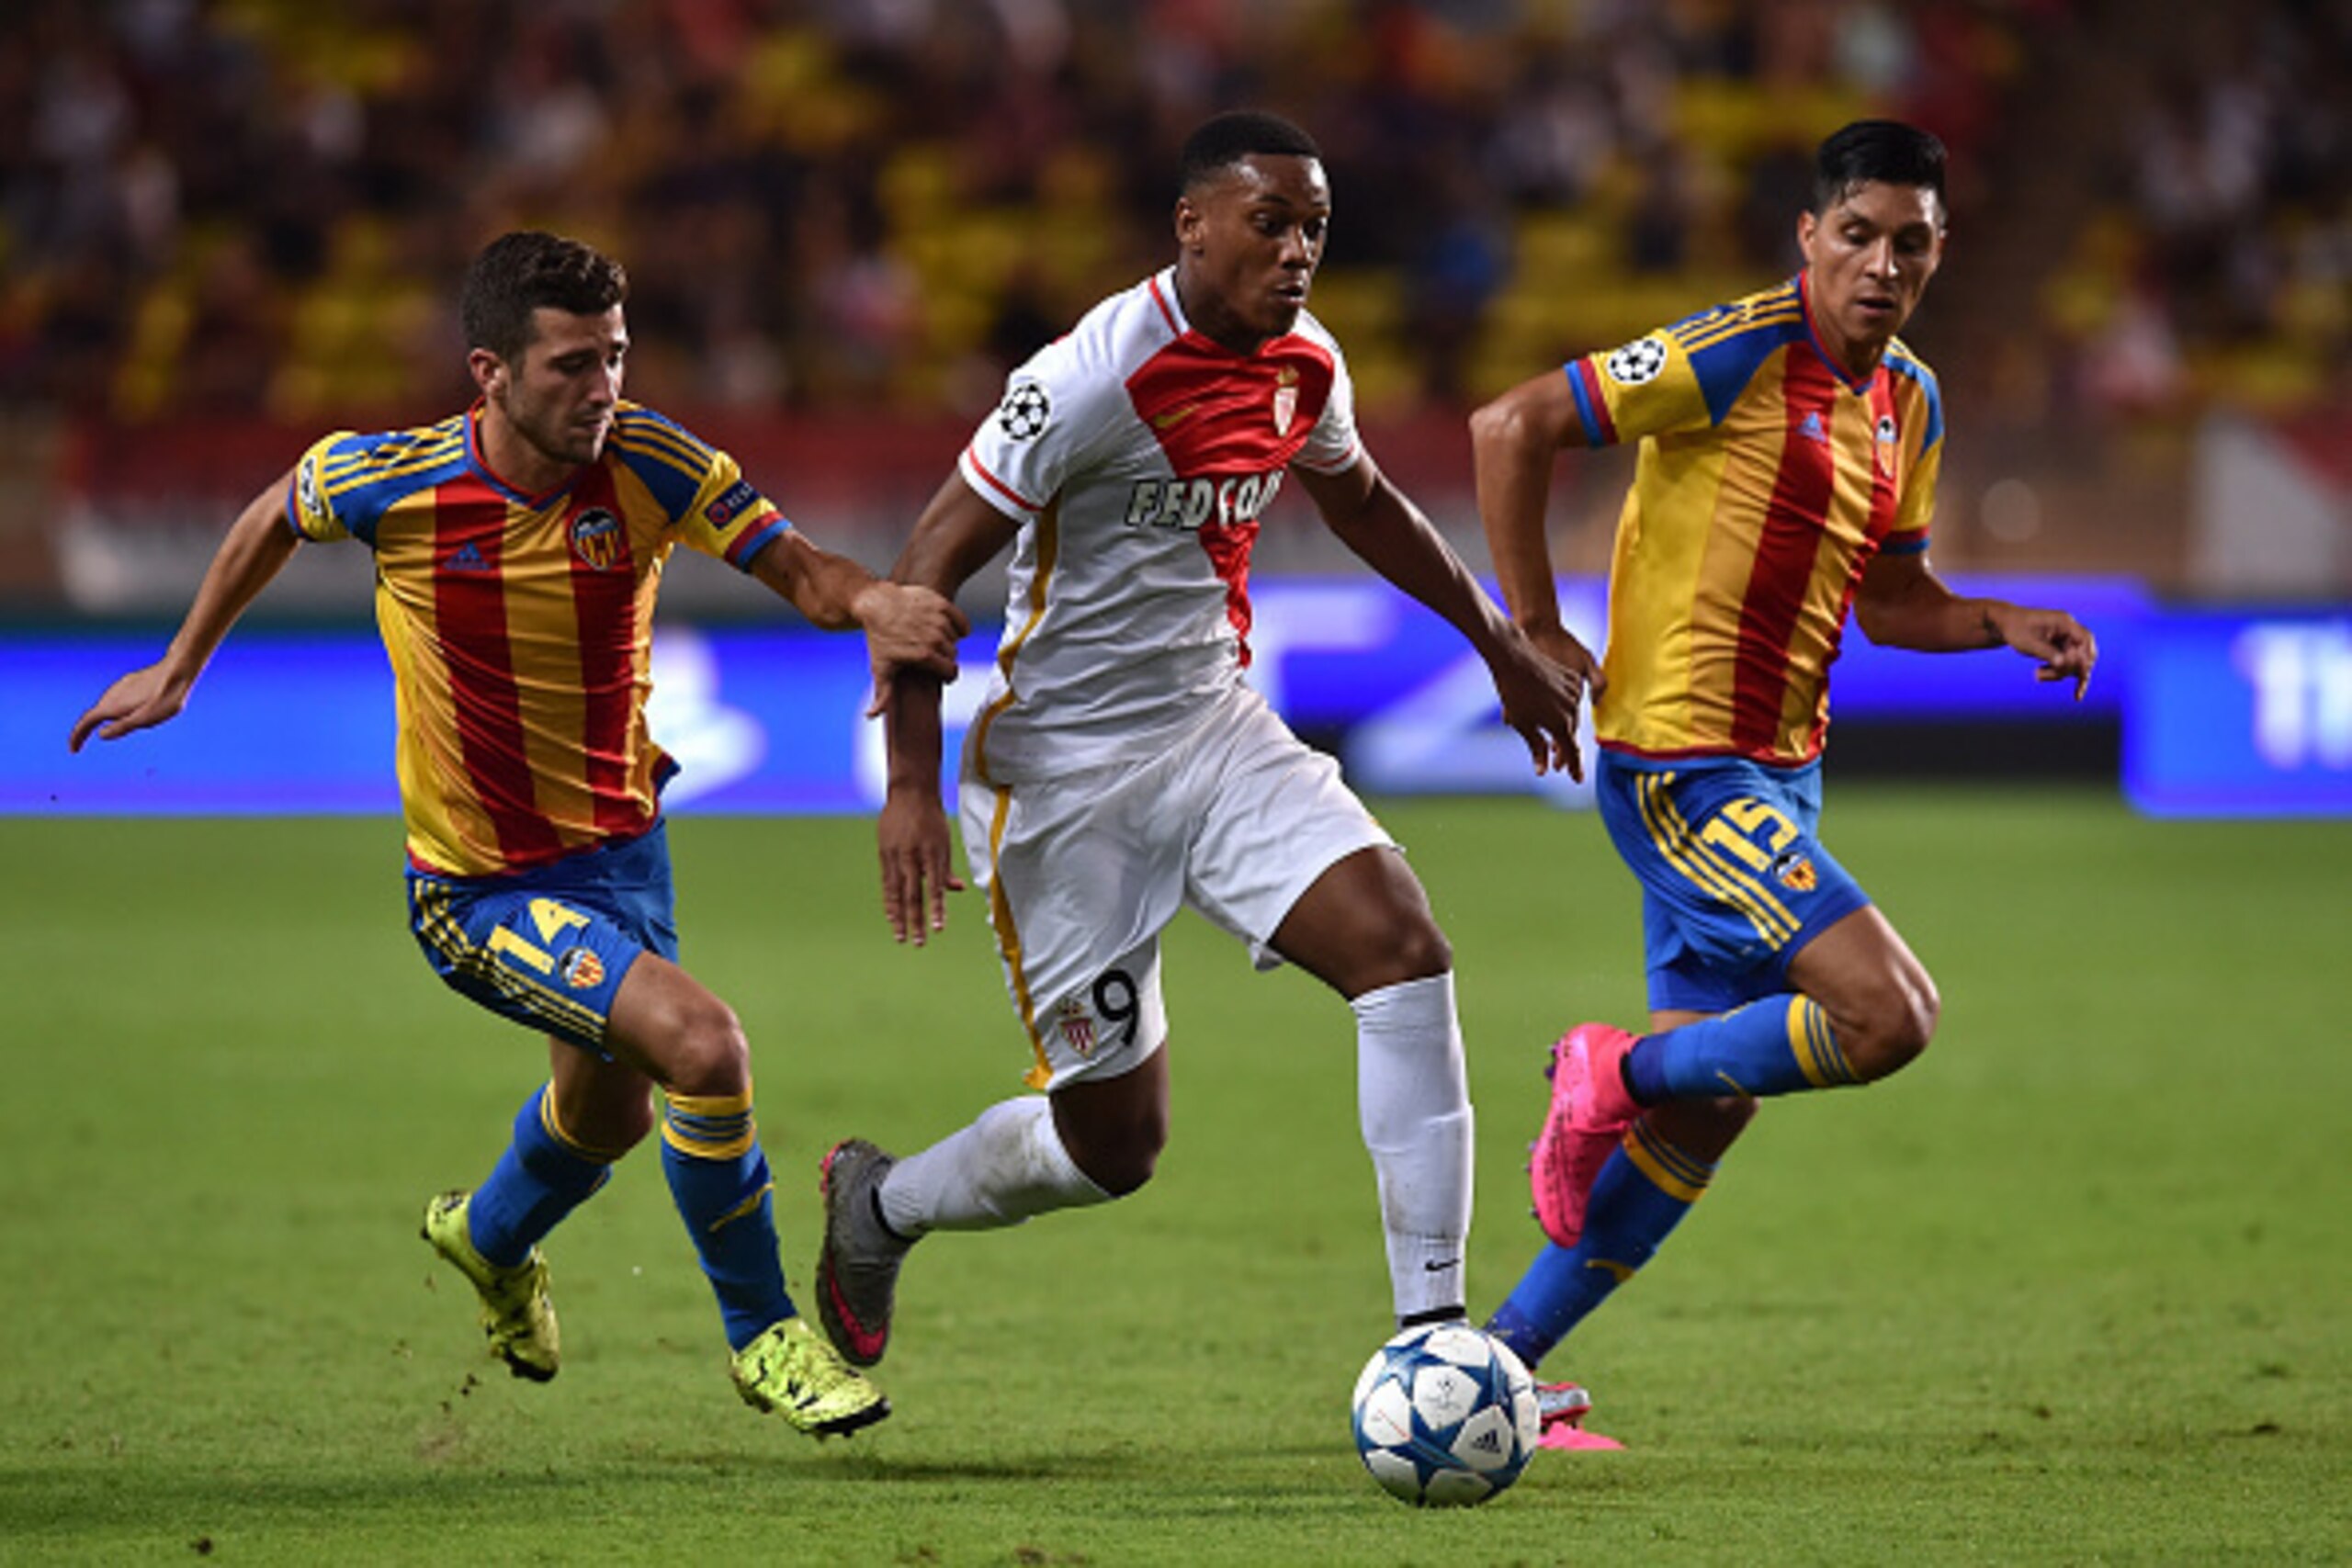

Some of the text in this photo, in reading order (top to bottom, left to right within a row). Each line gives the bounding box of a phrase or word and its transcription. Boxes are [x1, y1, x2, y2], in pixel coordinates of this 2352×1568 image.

[1702, 797, 1798, 872] 15
[487, 897, 591, 975] 14
[1092, 970, 1140, 1046] 9
